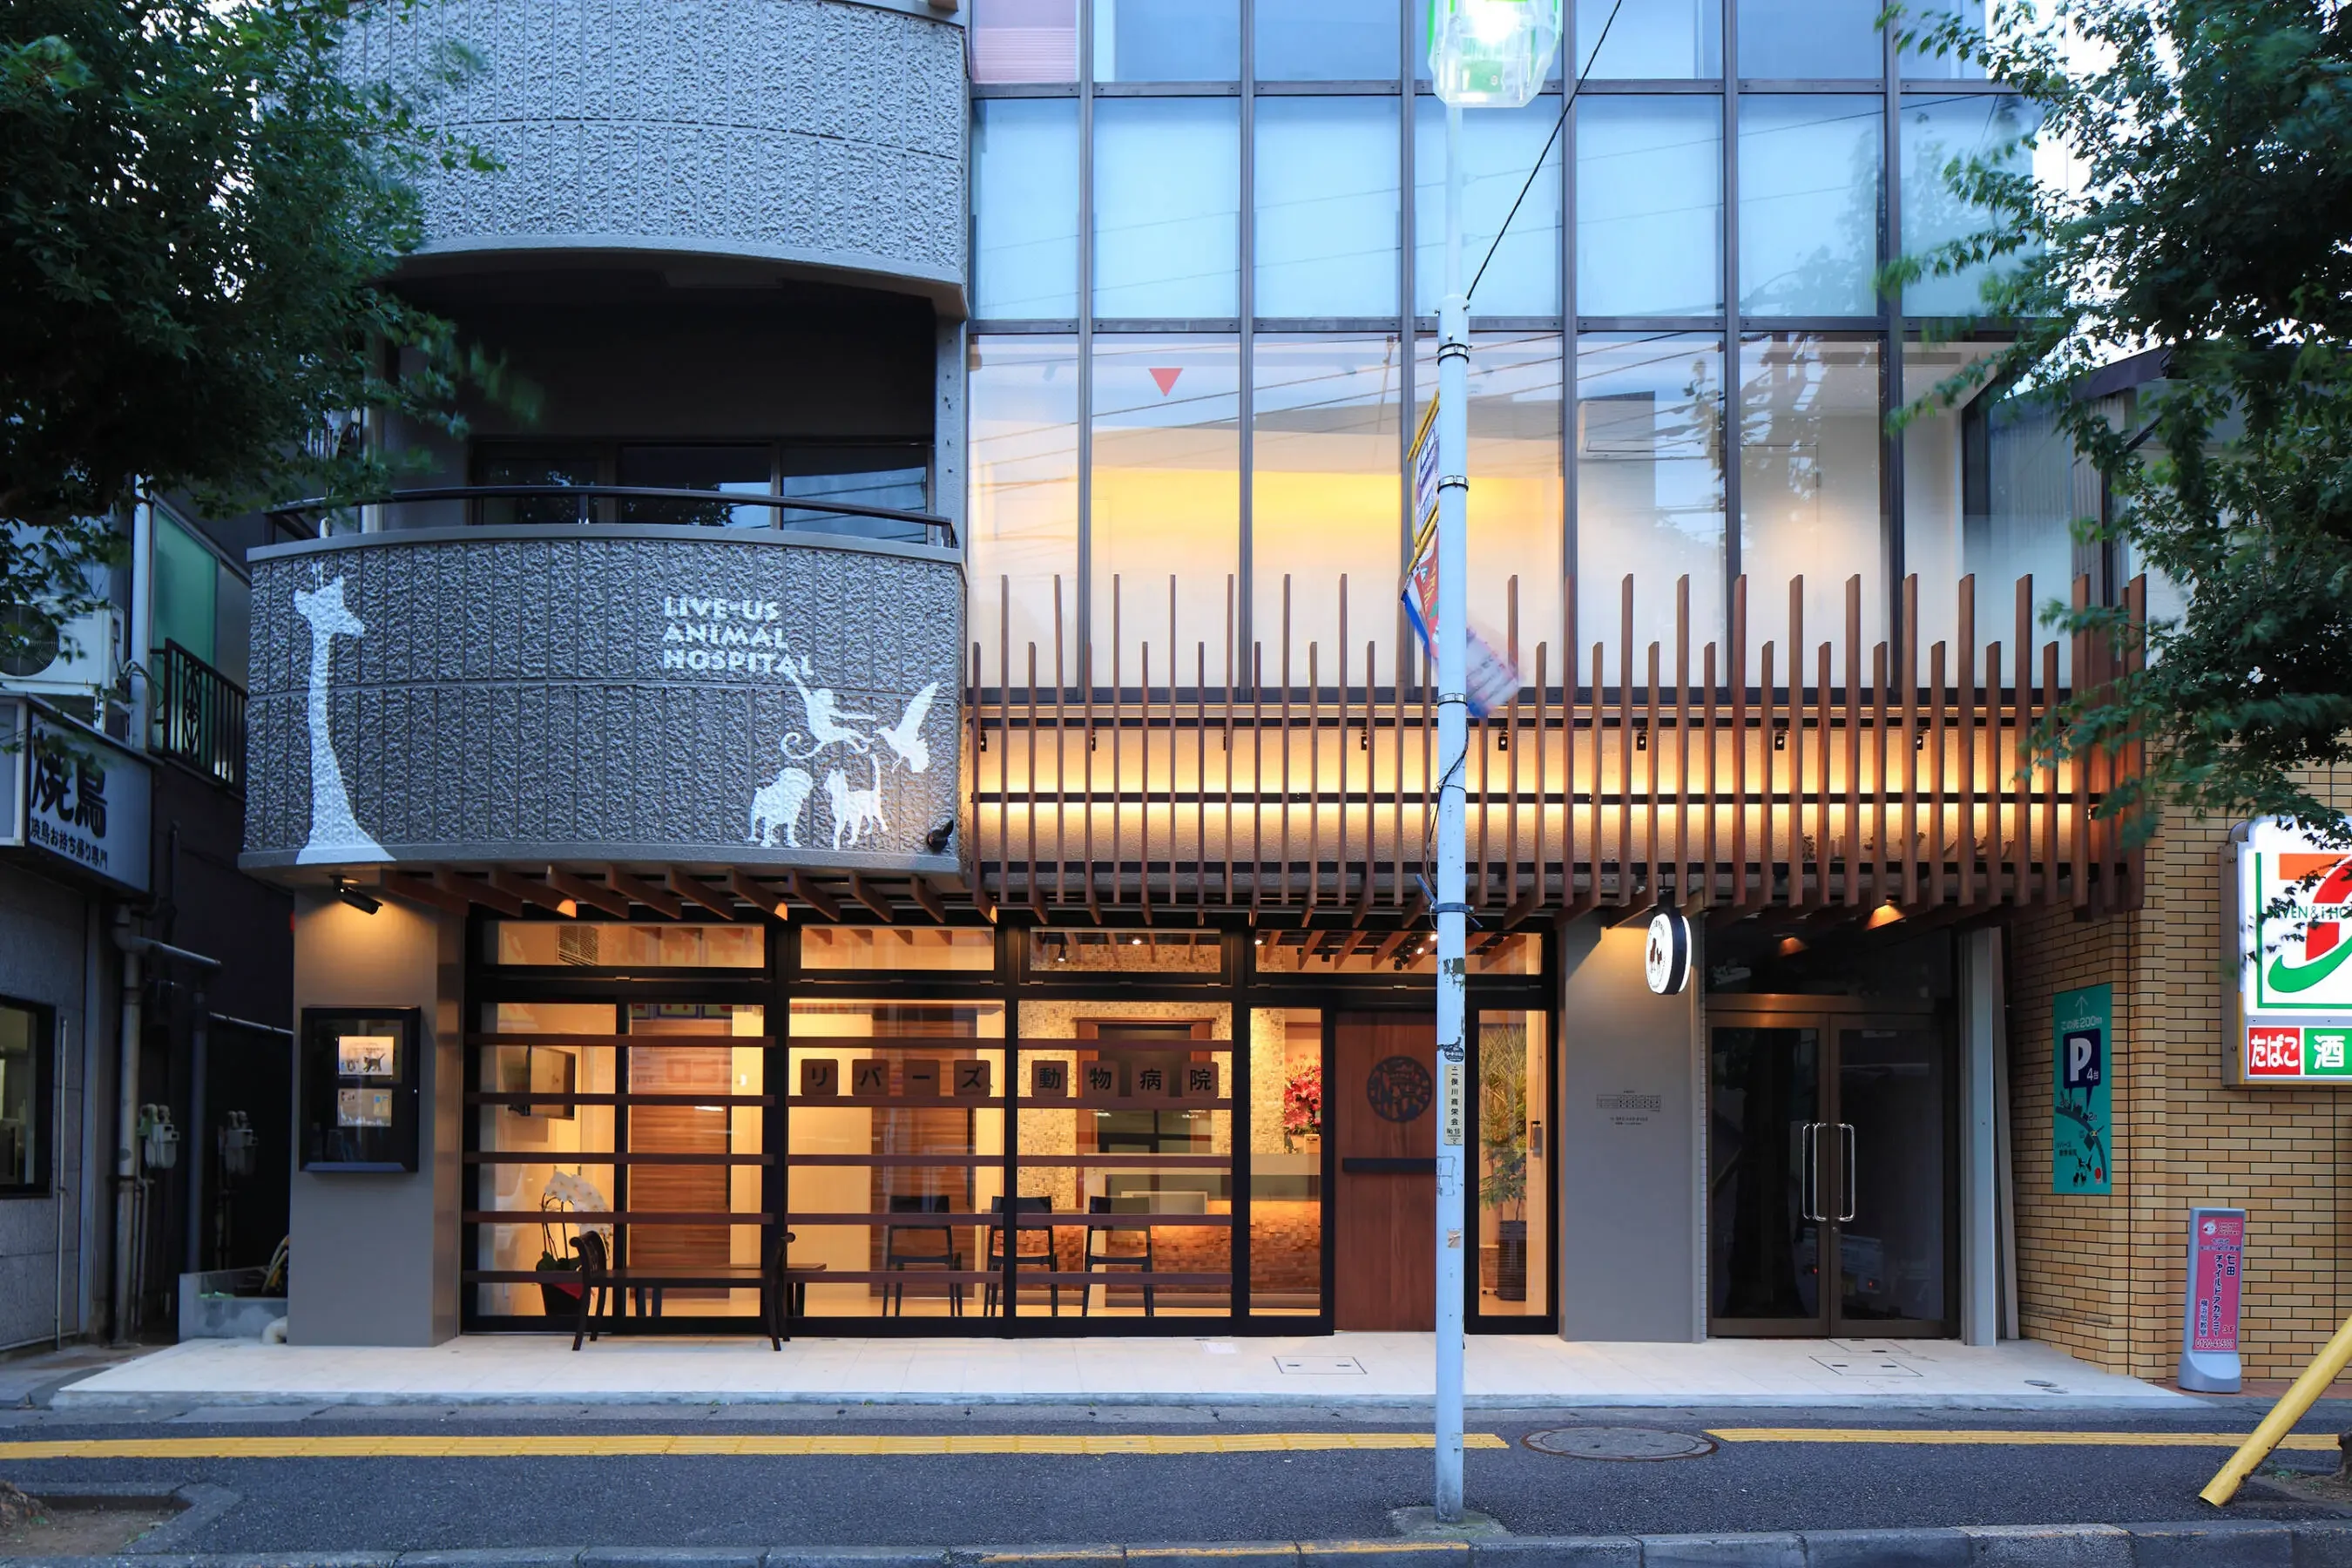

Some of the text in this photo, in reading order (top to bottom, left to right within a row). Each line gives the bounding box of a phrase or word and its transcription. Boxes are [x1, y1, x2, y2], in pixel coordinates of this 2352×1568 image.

[662, 623, 788, 648] ANIMAL
[663, 649, 815, 676] HOSPITAL
[2070, 1037, 2092, 1081] P
[2250, 1034, 2346, 1069] たばこ 酒
[811, 1067, 1213, 1092] リバーズ 動物病院
[2227, 1254, 2236, 1276] 七田
[2213, 1254, 2224, 1337] チャイルドアカデミー
